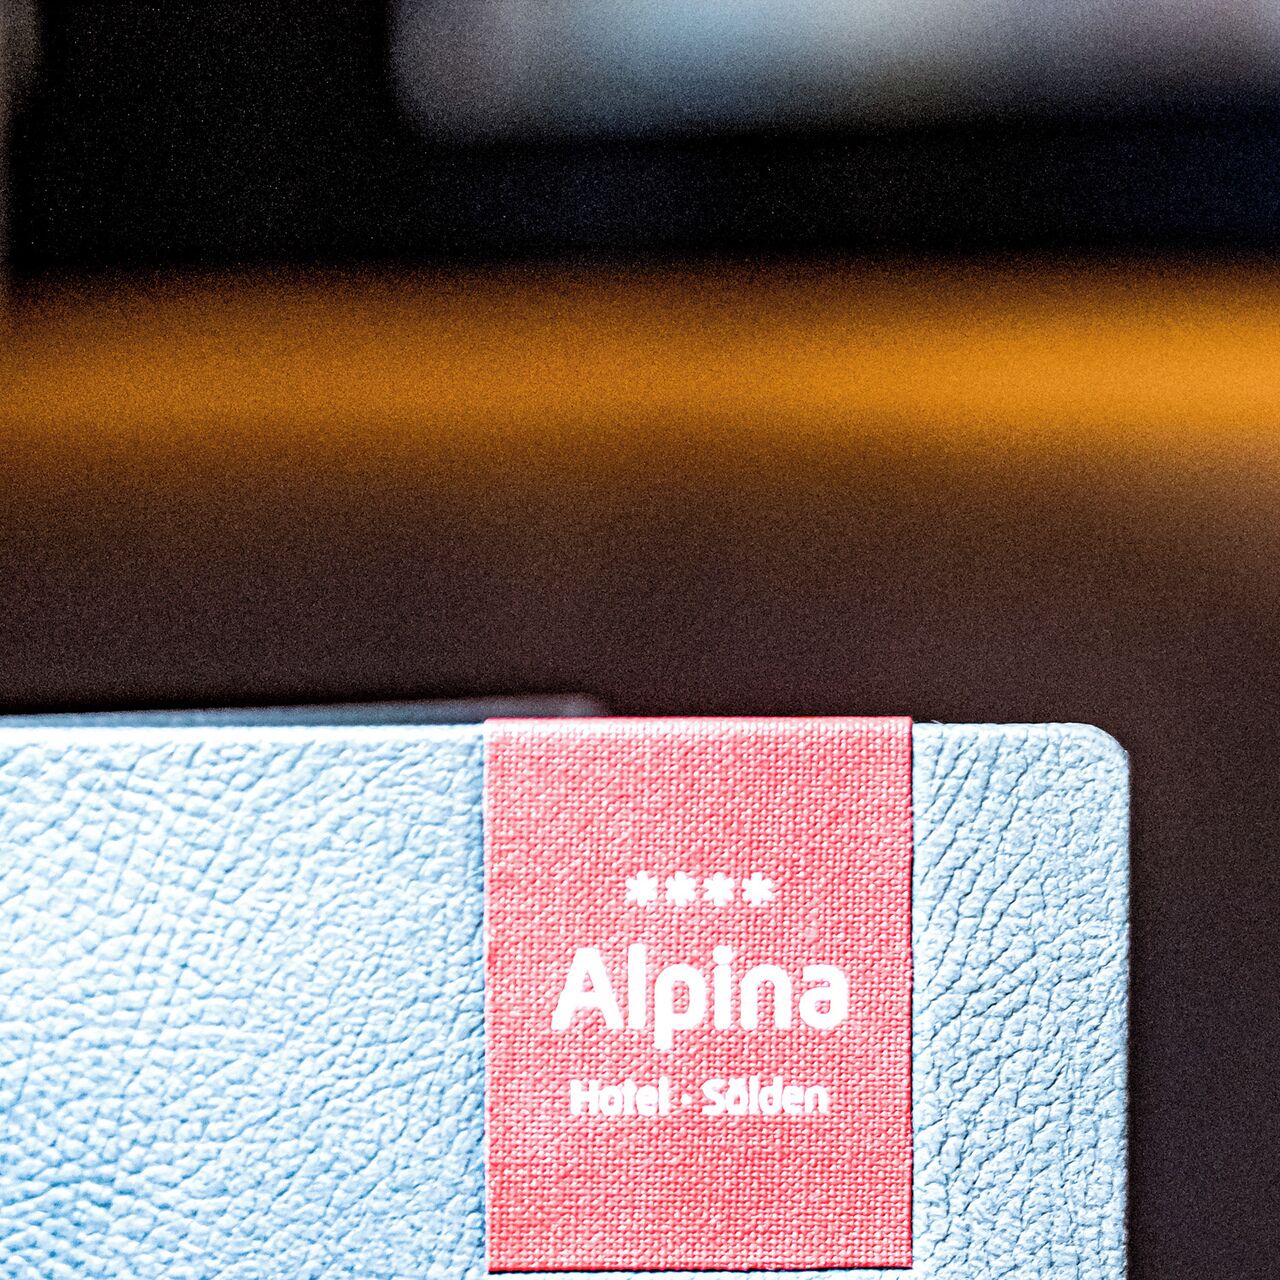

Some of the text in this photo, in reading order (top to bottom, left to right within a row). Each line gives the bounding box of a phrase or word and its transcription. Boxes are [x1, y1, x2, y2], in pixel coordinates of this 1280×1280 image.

[551, 943, 850, 1051] Alpina
[570, 1077, 829, 1116] Hotel Sölden
